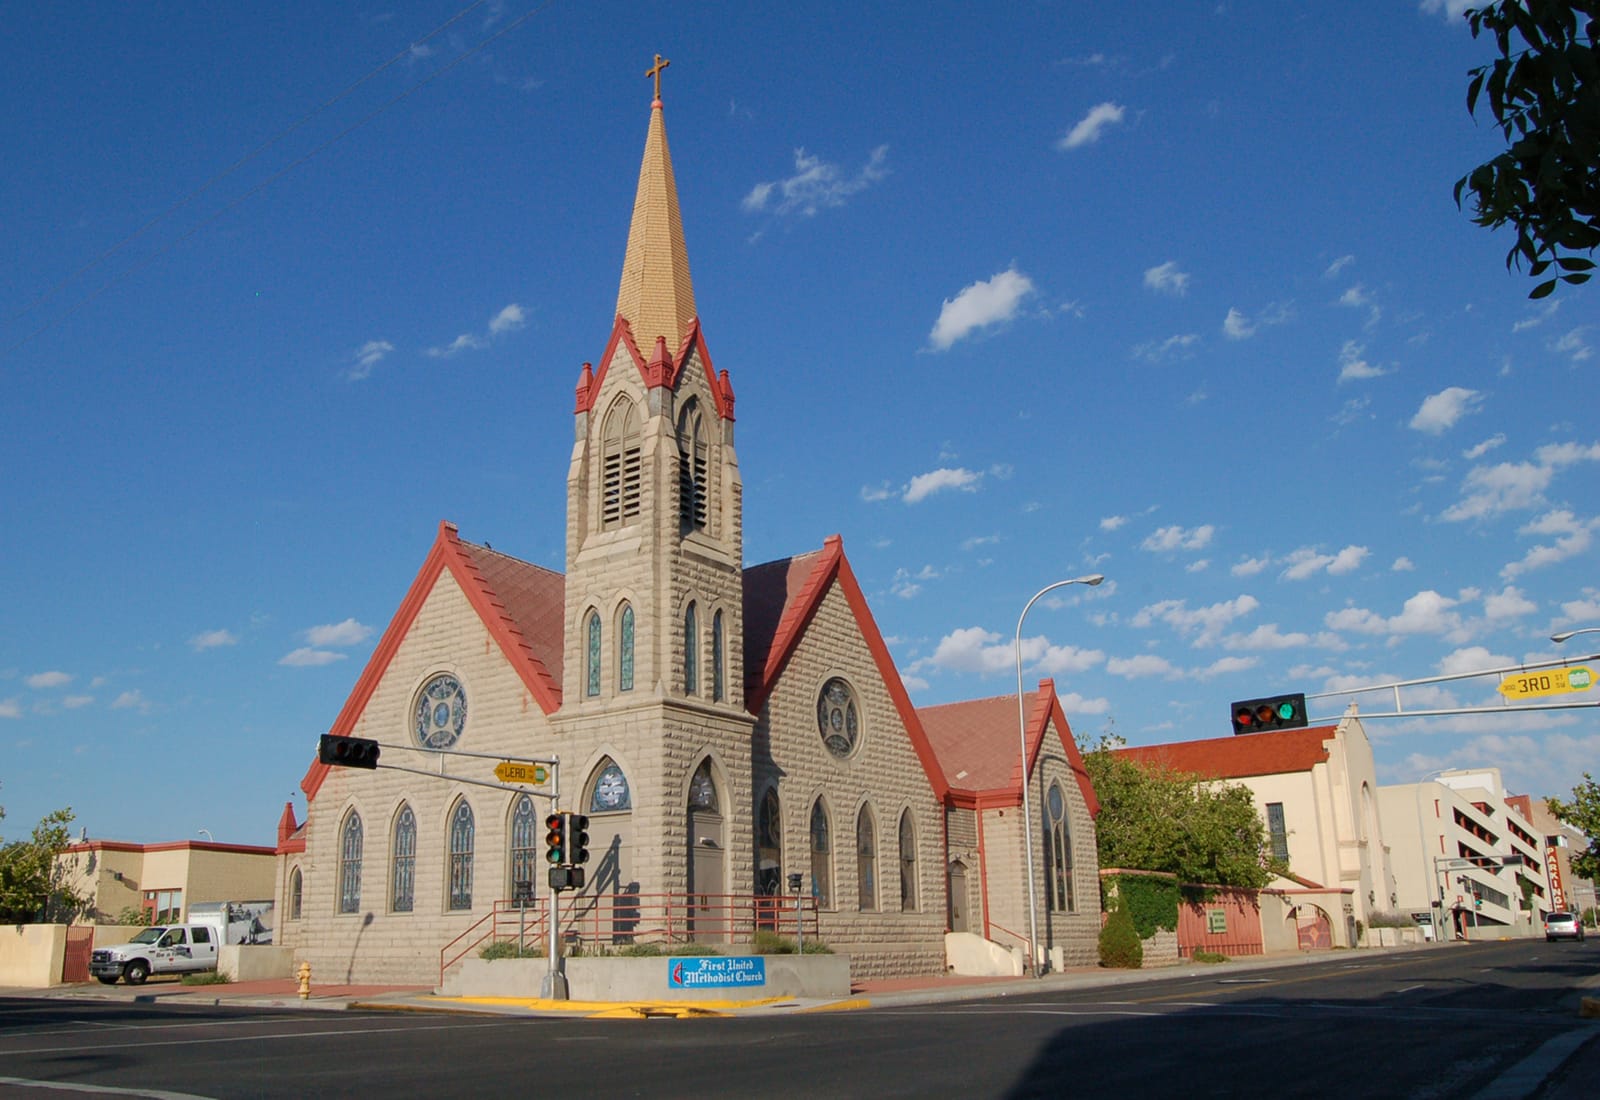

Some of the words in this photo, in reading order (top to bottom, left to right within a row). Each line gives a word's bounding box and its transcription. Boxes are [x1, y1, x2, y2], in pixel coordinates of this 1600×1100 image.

[1518, 676, 1550, 693] 3RD
[504, 767, 526, 779] LEAD
[1547, 847, 1564, 909] PARKING
[698, 960, 725, 974] First
[727, 960, 754, 973] United
[684, 970, 735, 987] Methodist
[735, 970, 763, 982] Church
